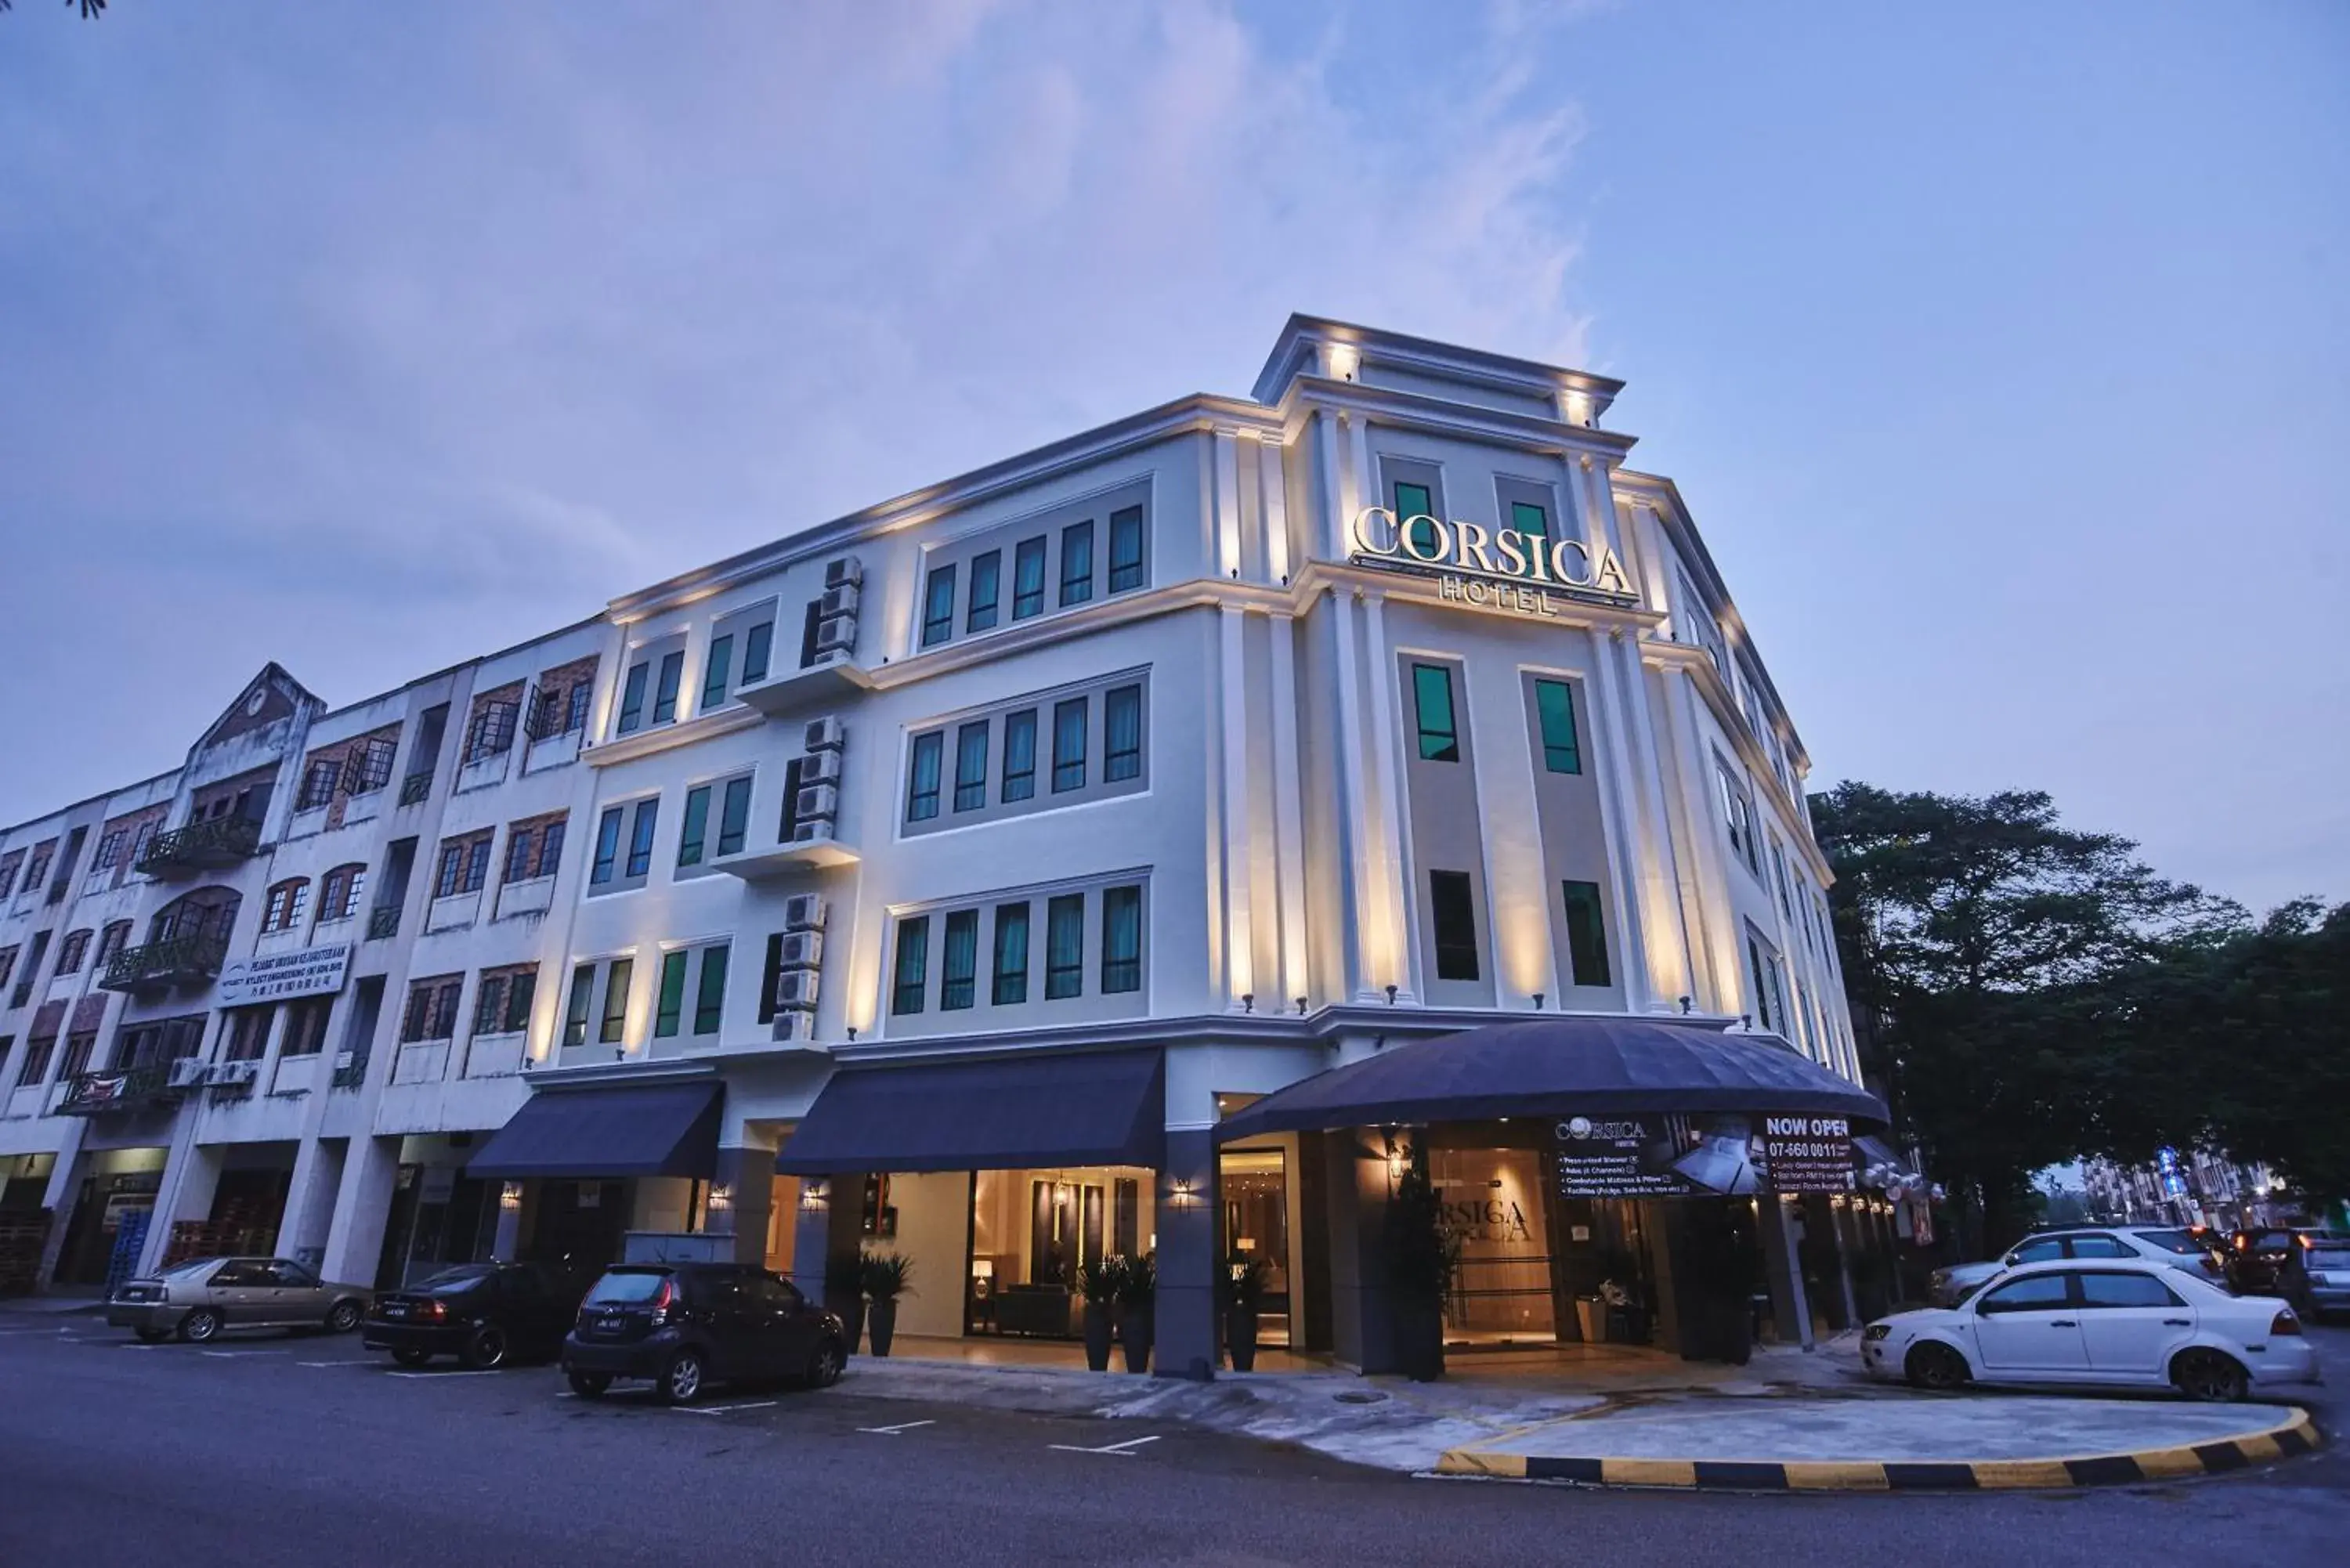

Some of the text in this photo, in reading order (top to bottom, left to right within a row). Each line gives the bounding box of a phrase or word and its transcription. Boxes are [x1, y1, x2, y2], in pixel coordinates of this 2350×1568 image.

[1353, 506, 1636, 595] CORSICA
[1438, 575, 1558, 617] HOTEL
[1766, 1118, 1849, 1136] NOW OPEN
